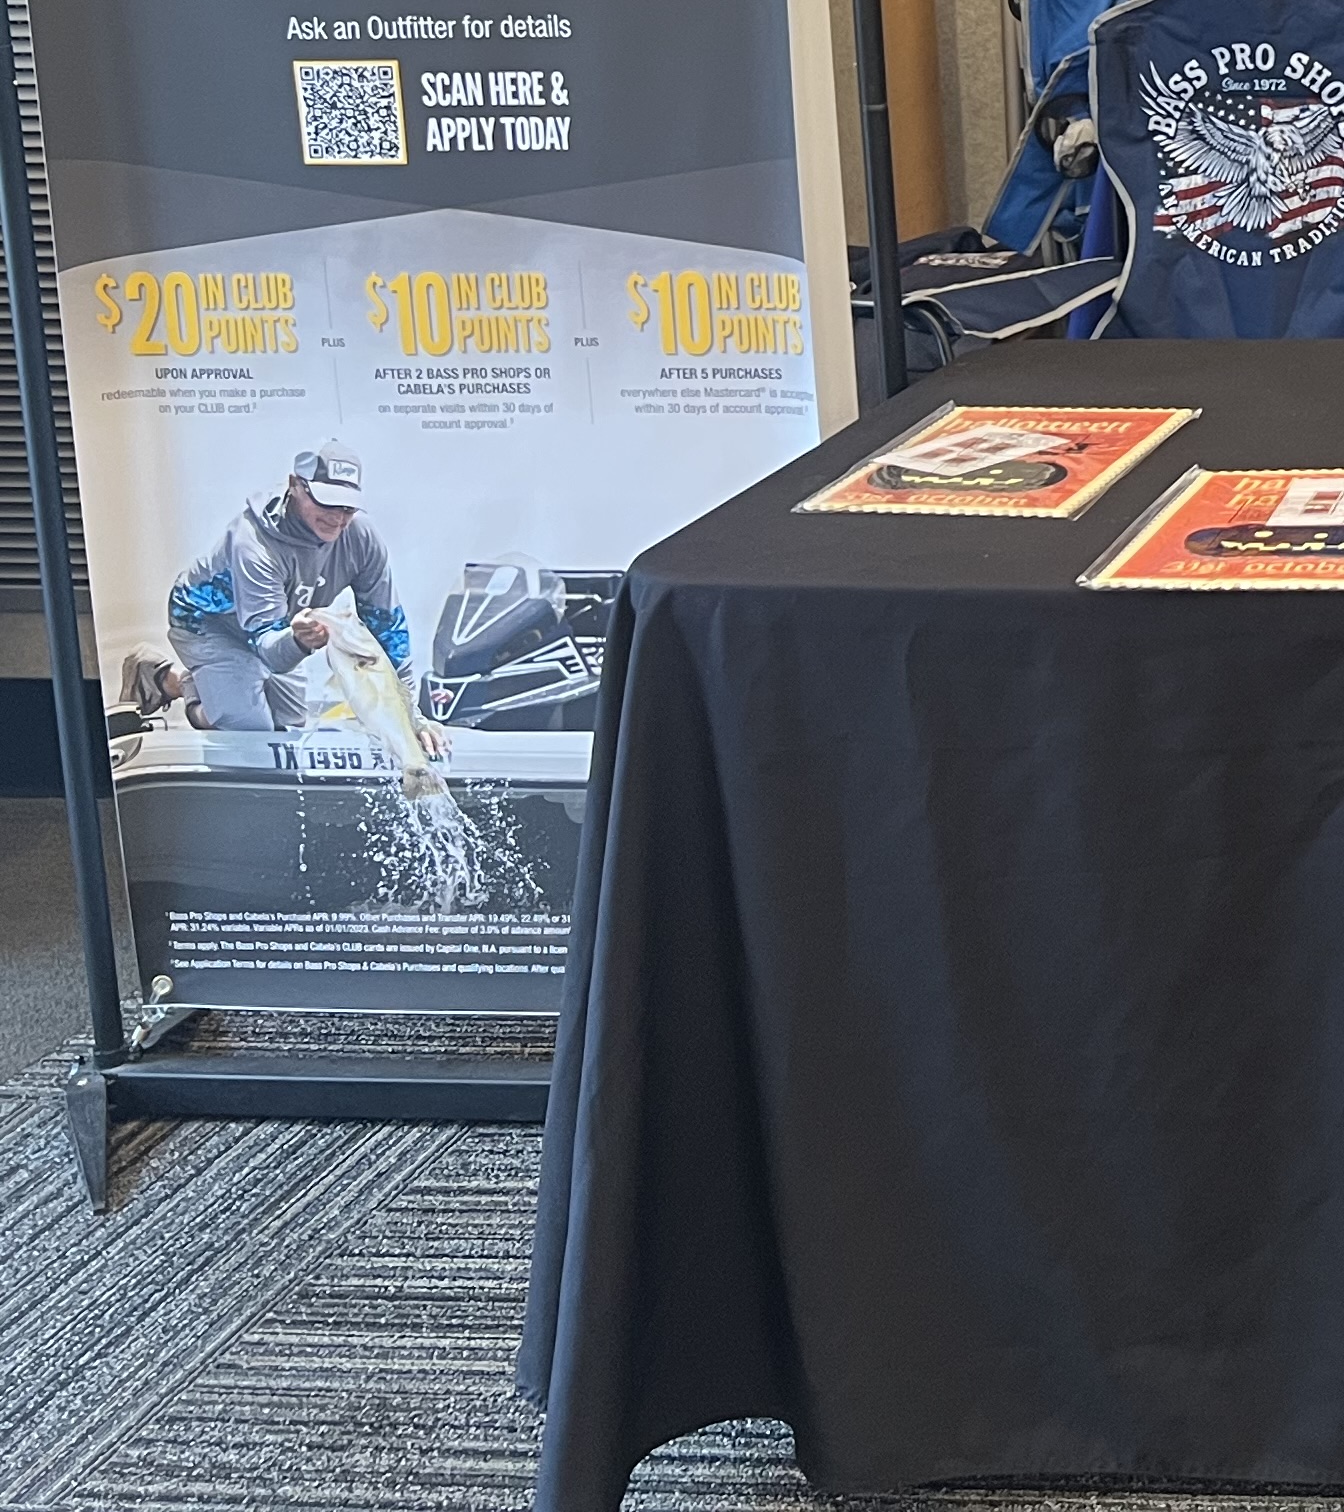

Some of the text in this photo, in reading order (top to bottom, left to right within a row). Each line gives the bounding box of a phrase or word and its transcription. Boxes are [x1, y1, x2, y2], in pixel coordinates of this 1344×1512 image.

[287, 14, 572, 40] Ask an Outfitter for details
[421, 71, 570, 107] SCAN HERE &
[1148, 59, 1208, 138] BASS
[1211, 42, 1276, 76] PRO
[1221, 78, 1287, 92] Since 1972
[426, 116, 571, 152] APPLY TODAY
[1158, 182, 1179, 209] AN
[1171, 213, 1262, 267] AMERICAN
[94, 270, 294, 356] $20 IN CLUB
[364, 271, 548, 356] $10 IN CLUB
[626, 270, 802, 356] $10 IN CLUB
[203, 314, 298, 354] POINTS
[321, 337, 346, 348] PLUS
[455, 314, 552, 354] POINTS
[574, 336, 599, 347] PLUS
[716, 314, 804, 355] POINTS
[155, 367, 254, 380] UPON APPROVAL
[374, 367, 552, 380] AFTER 2 BASS PRO SHOPS OR
[397, 383, 532, 395] CABELA'S PURCHASES
[660, 367, 783, 380] AFTER 5 PURCHASES
[169, 387, 197, 398] when
[219, 387, 247, 398] make
[259, 387, 306, 401] purchase
